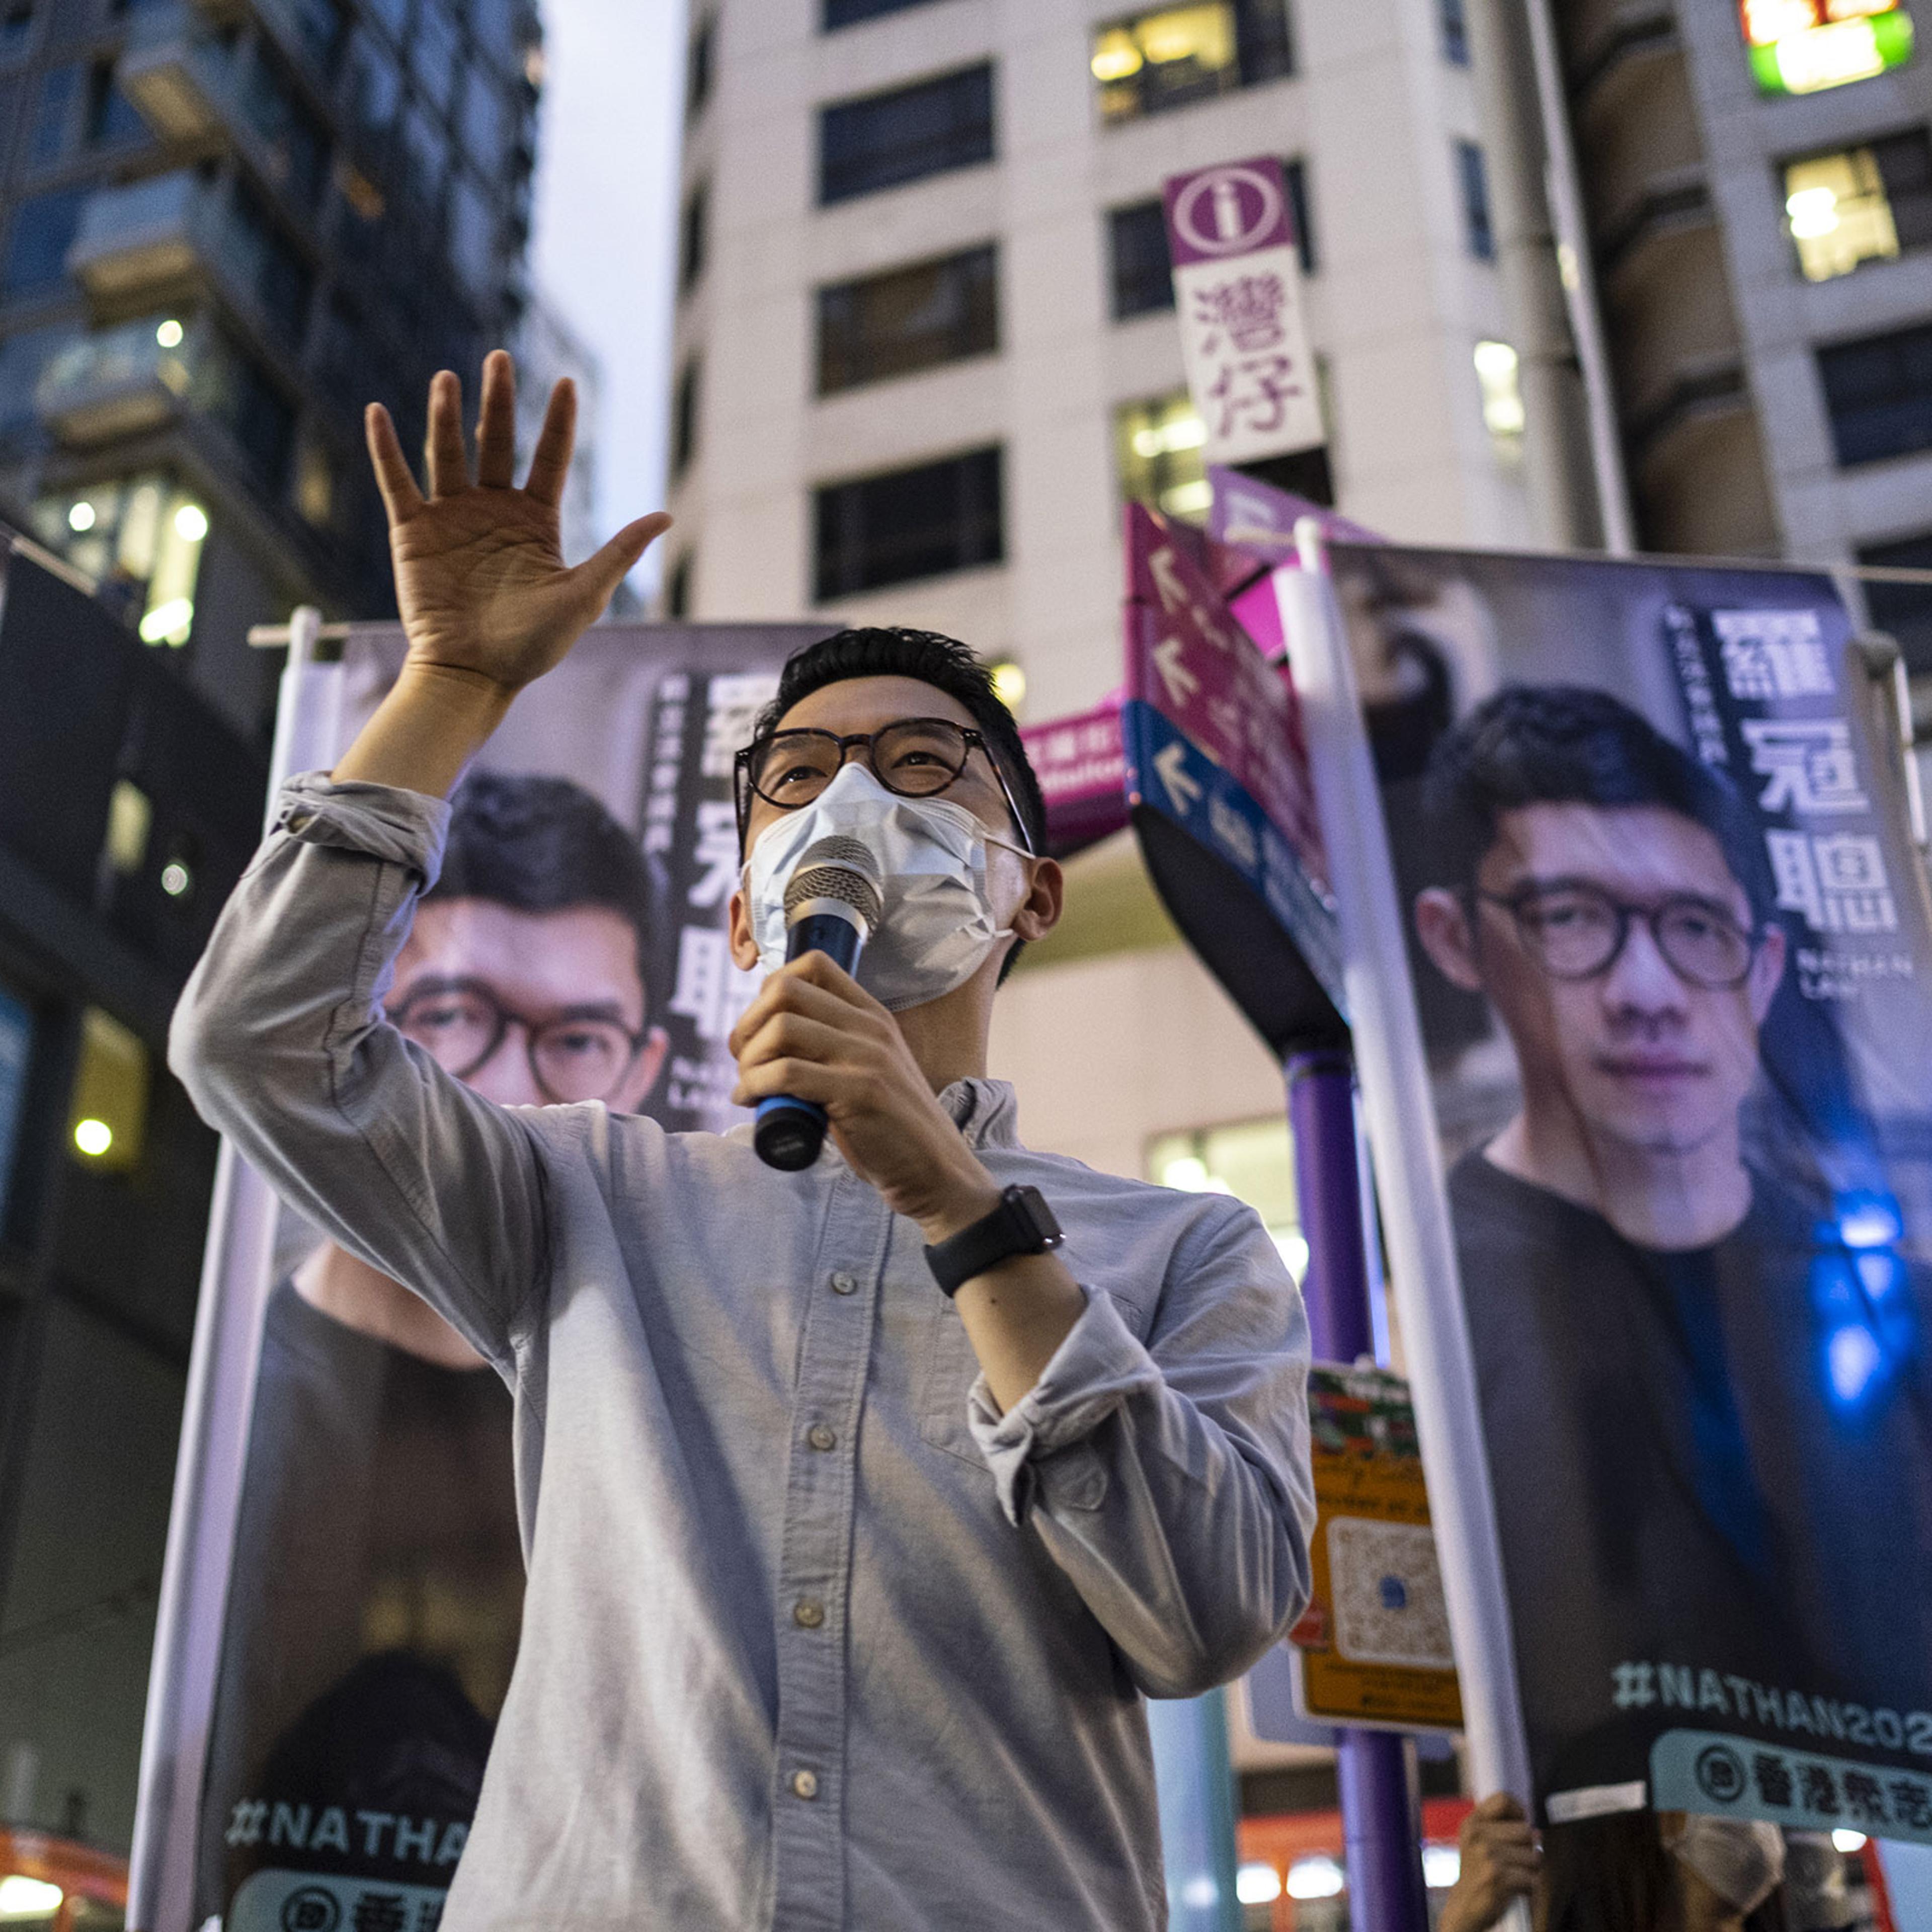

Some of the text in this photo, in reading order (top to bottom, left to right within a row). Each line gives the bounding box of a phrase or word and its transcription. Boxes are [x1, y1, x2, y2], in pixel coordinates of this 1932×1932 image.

[1193, 274, 1303, 439] 灣仔
[1713, 609, 1899, 933] 羅冠聰
